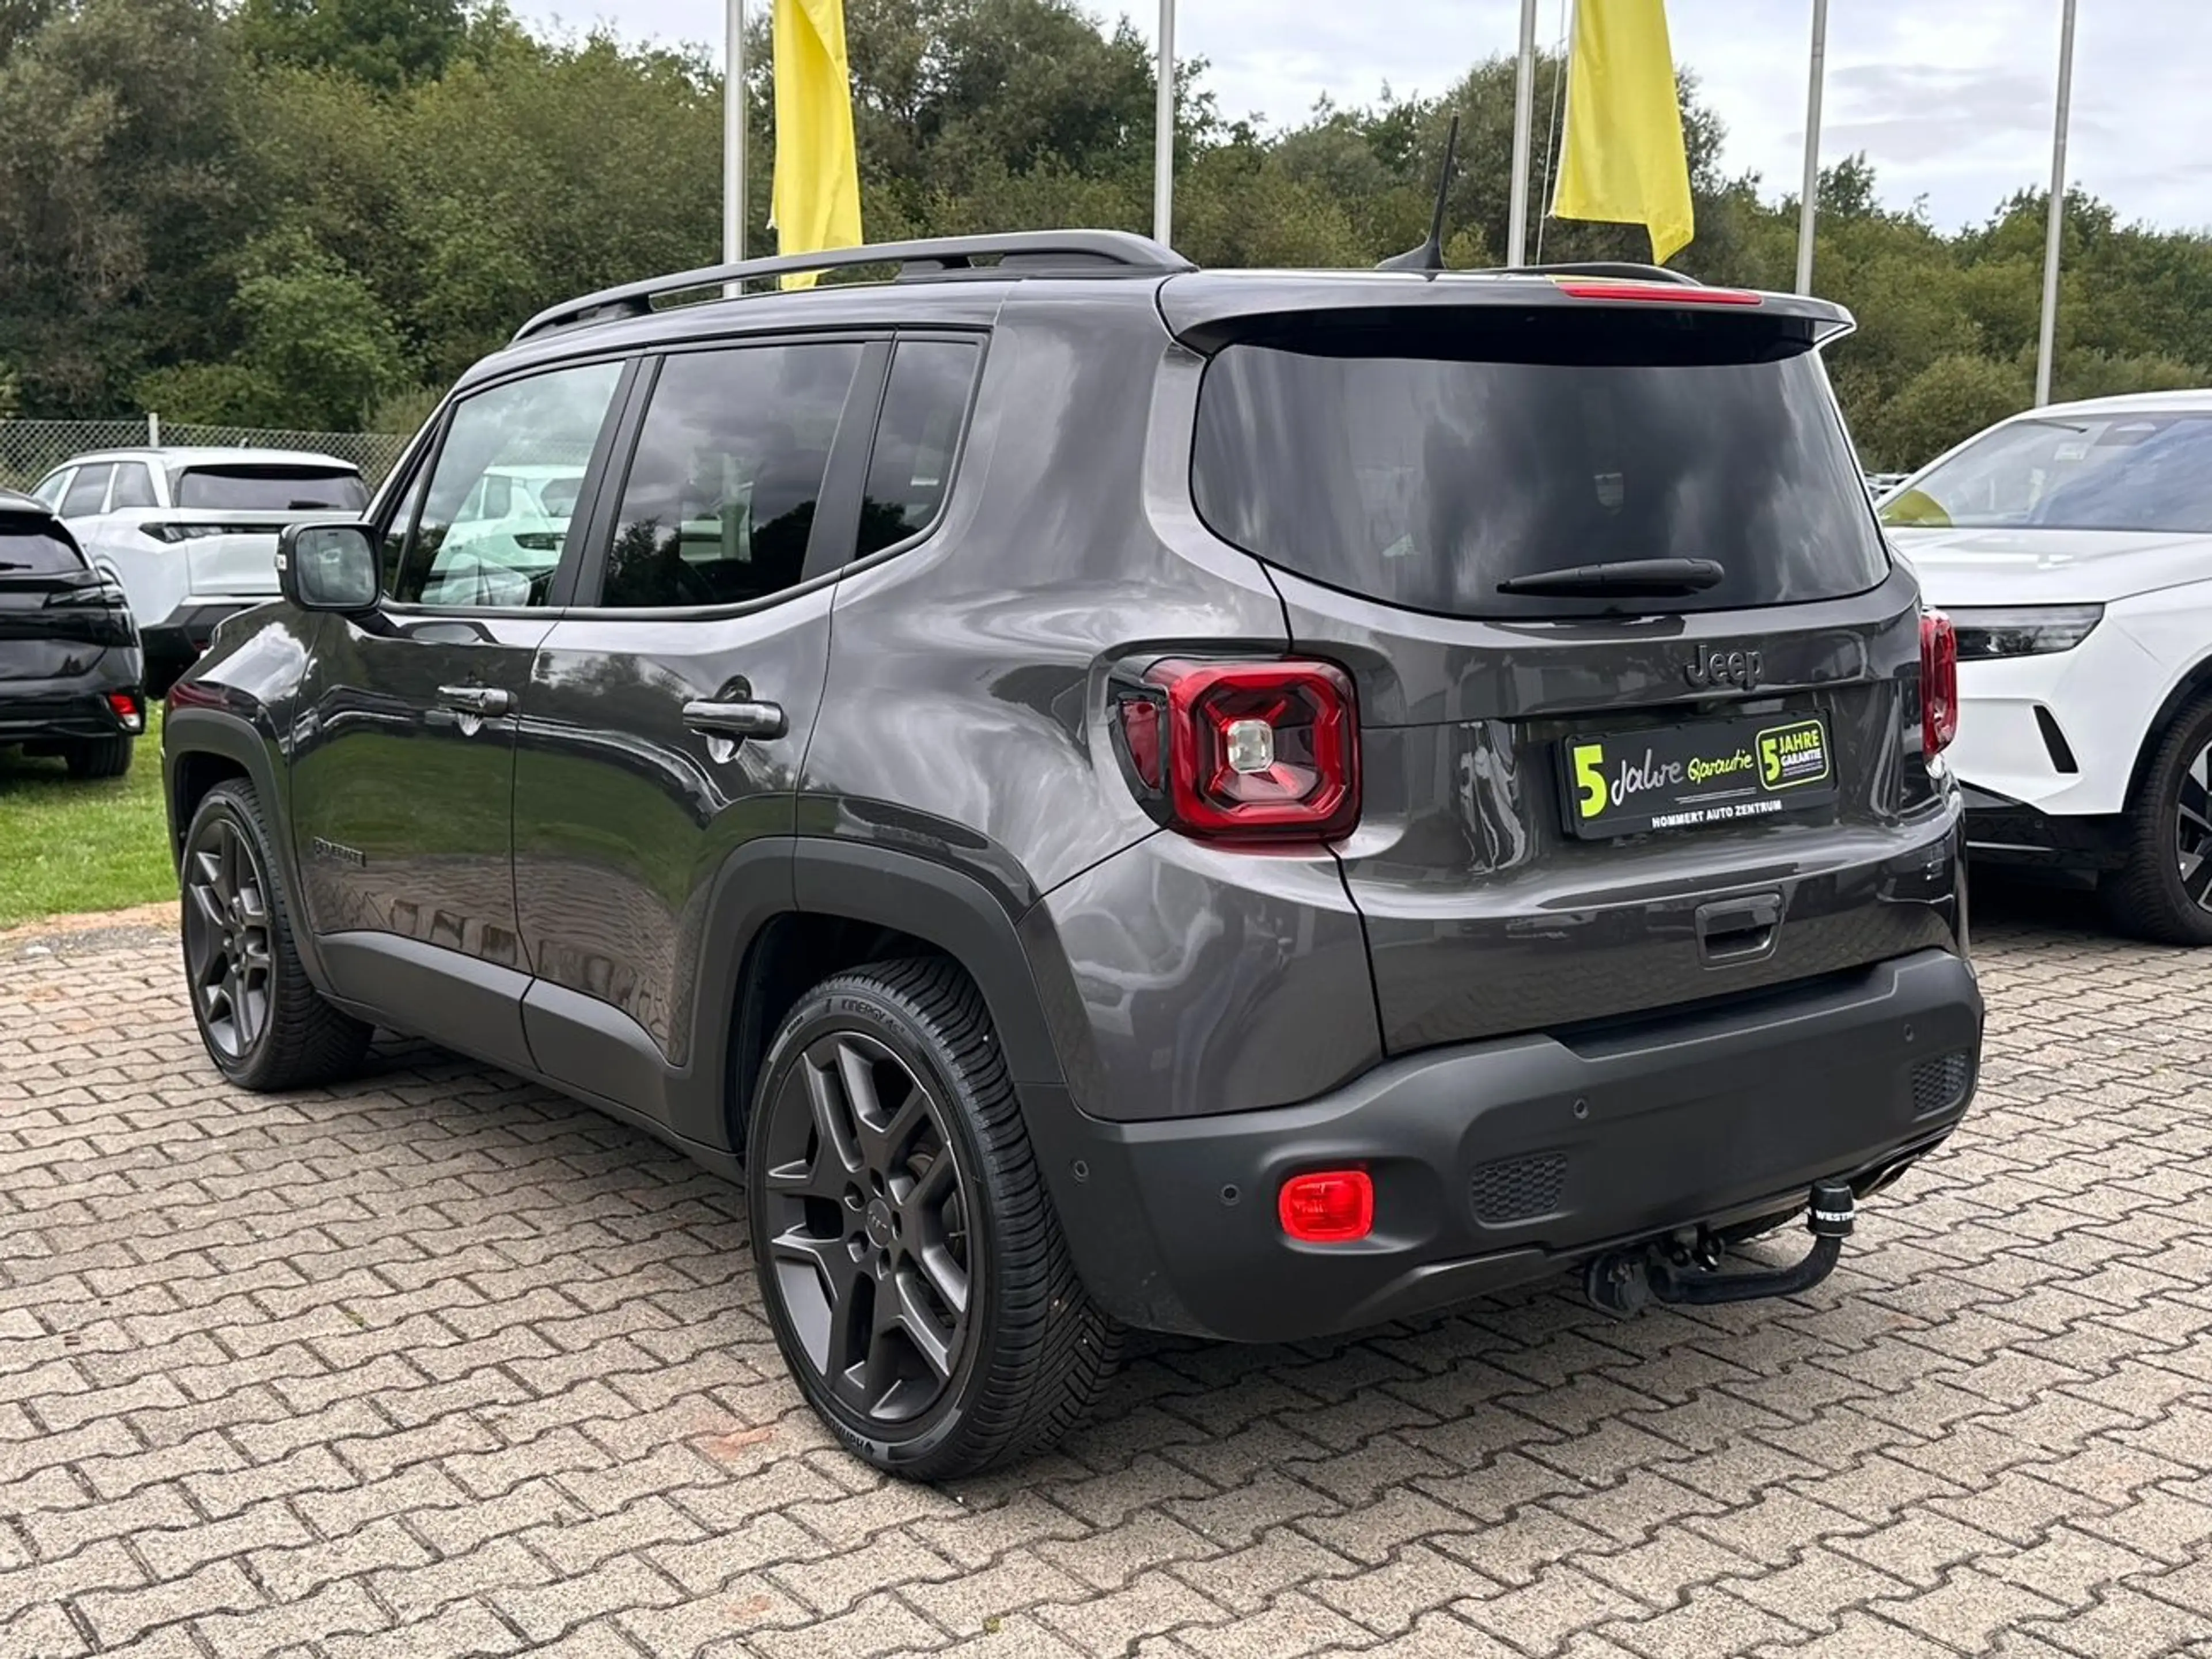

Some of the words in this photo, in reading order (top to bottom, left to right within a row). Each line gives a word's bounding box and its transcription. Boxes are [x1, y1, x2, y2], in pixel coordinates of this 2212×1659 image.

[1685, 643, 1765, 689] Jeep
[1762, 738, 1780, 781] 5
[1779, 729, 1820, 755] JAHRE
[1781, 748, 1823, 767] GARANTIE
[1574, 744, 1607, 817] 5
[1611, 748, 1683, 806] Jahre
[1688, 749, 1753, 785] Garantie
[1652, 810, 1705, 828] HOMMERT
[1706, 807, 1733, 820] AUTO
[1736, 800, 1782, 816] ZENTRUM
